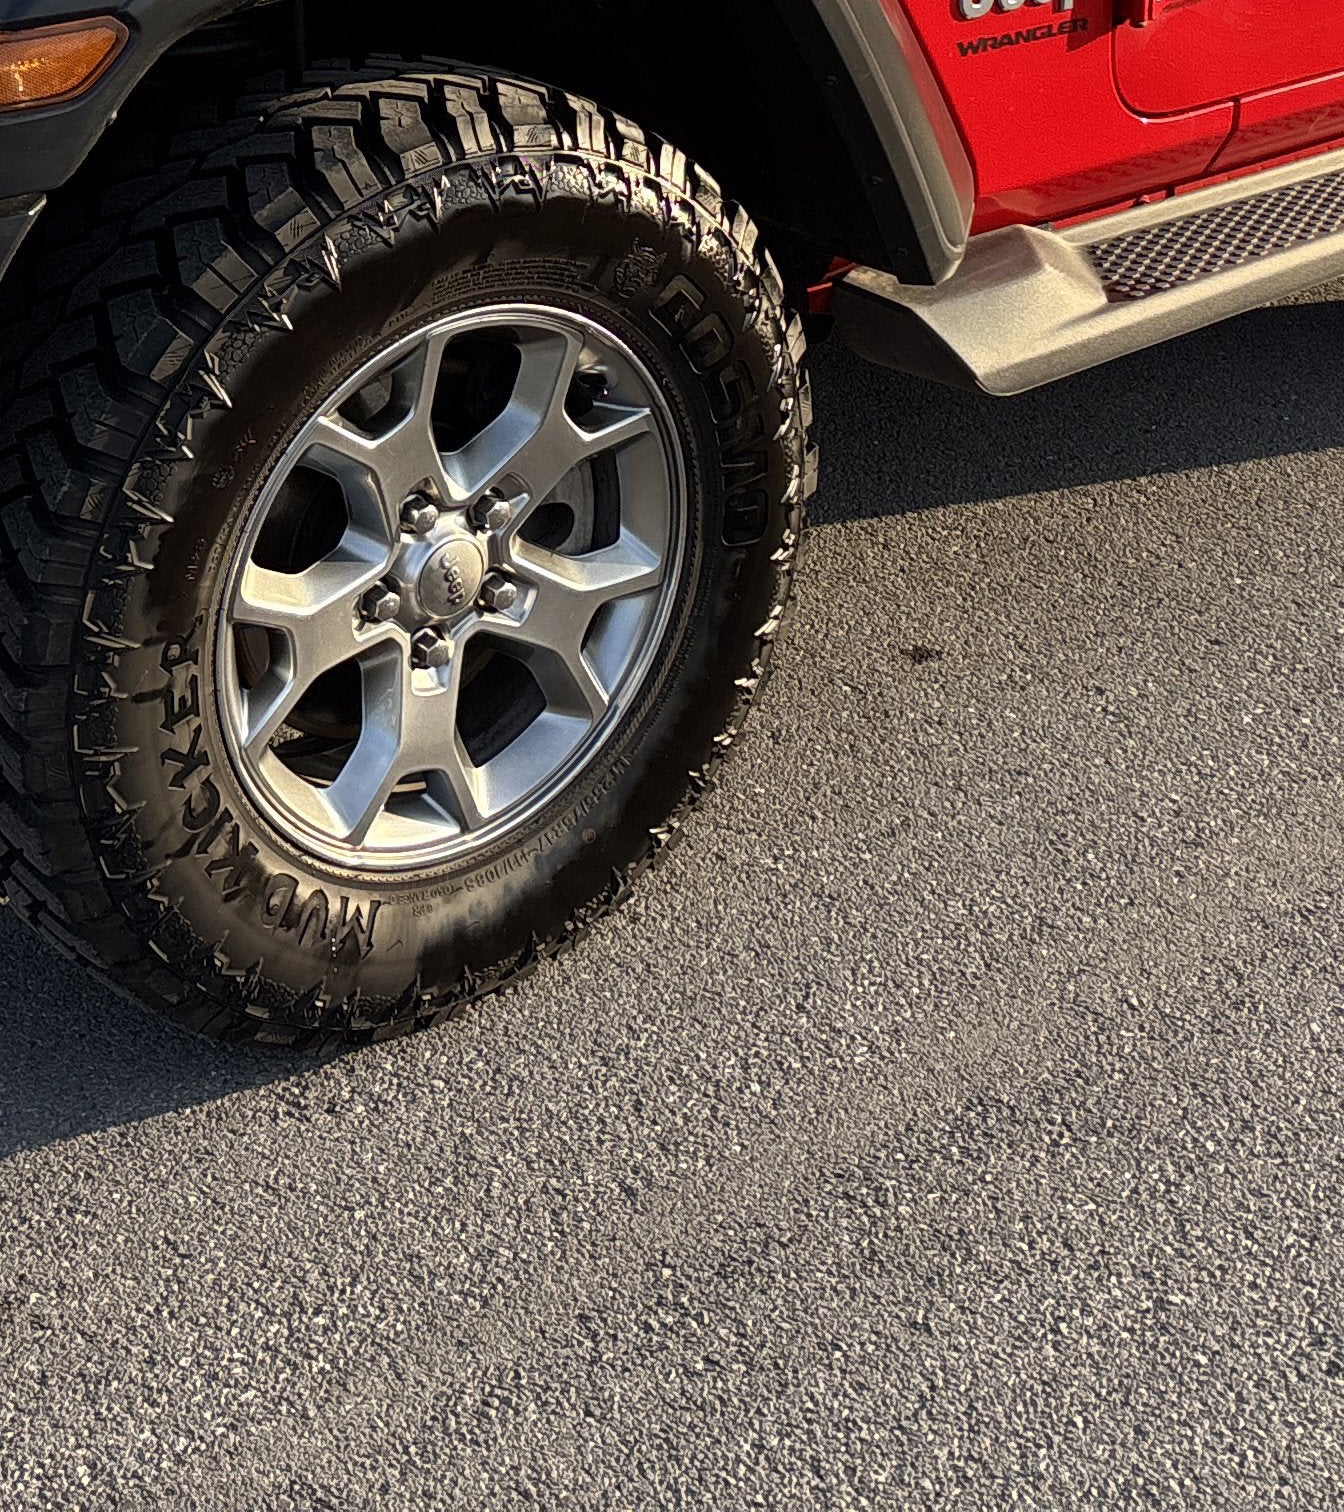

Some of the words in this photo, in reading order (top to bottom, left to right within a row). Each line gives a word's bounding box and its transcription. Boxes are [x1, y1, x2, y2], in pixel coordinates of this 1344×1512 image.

[957, 18, 1089, 57] WRANGLER
[648, 273, 769, 547] COSMO
[439, 552, 466, 603] Jeep
